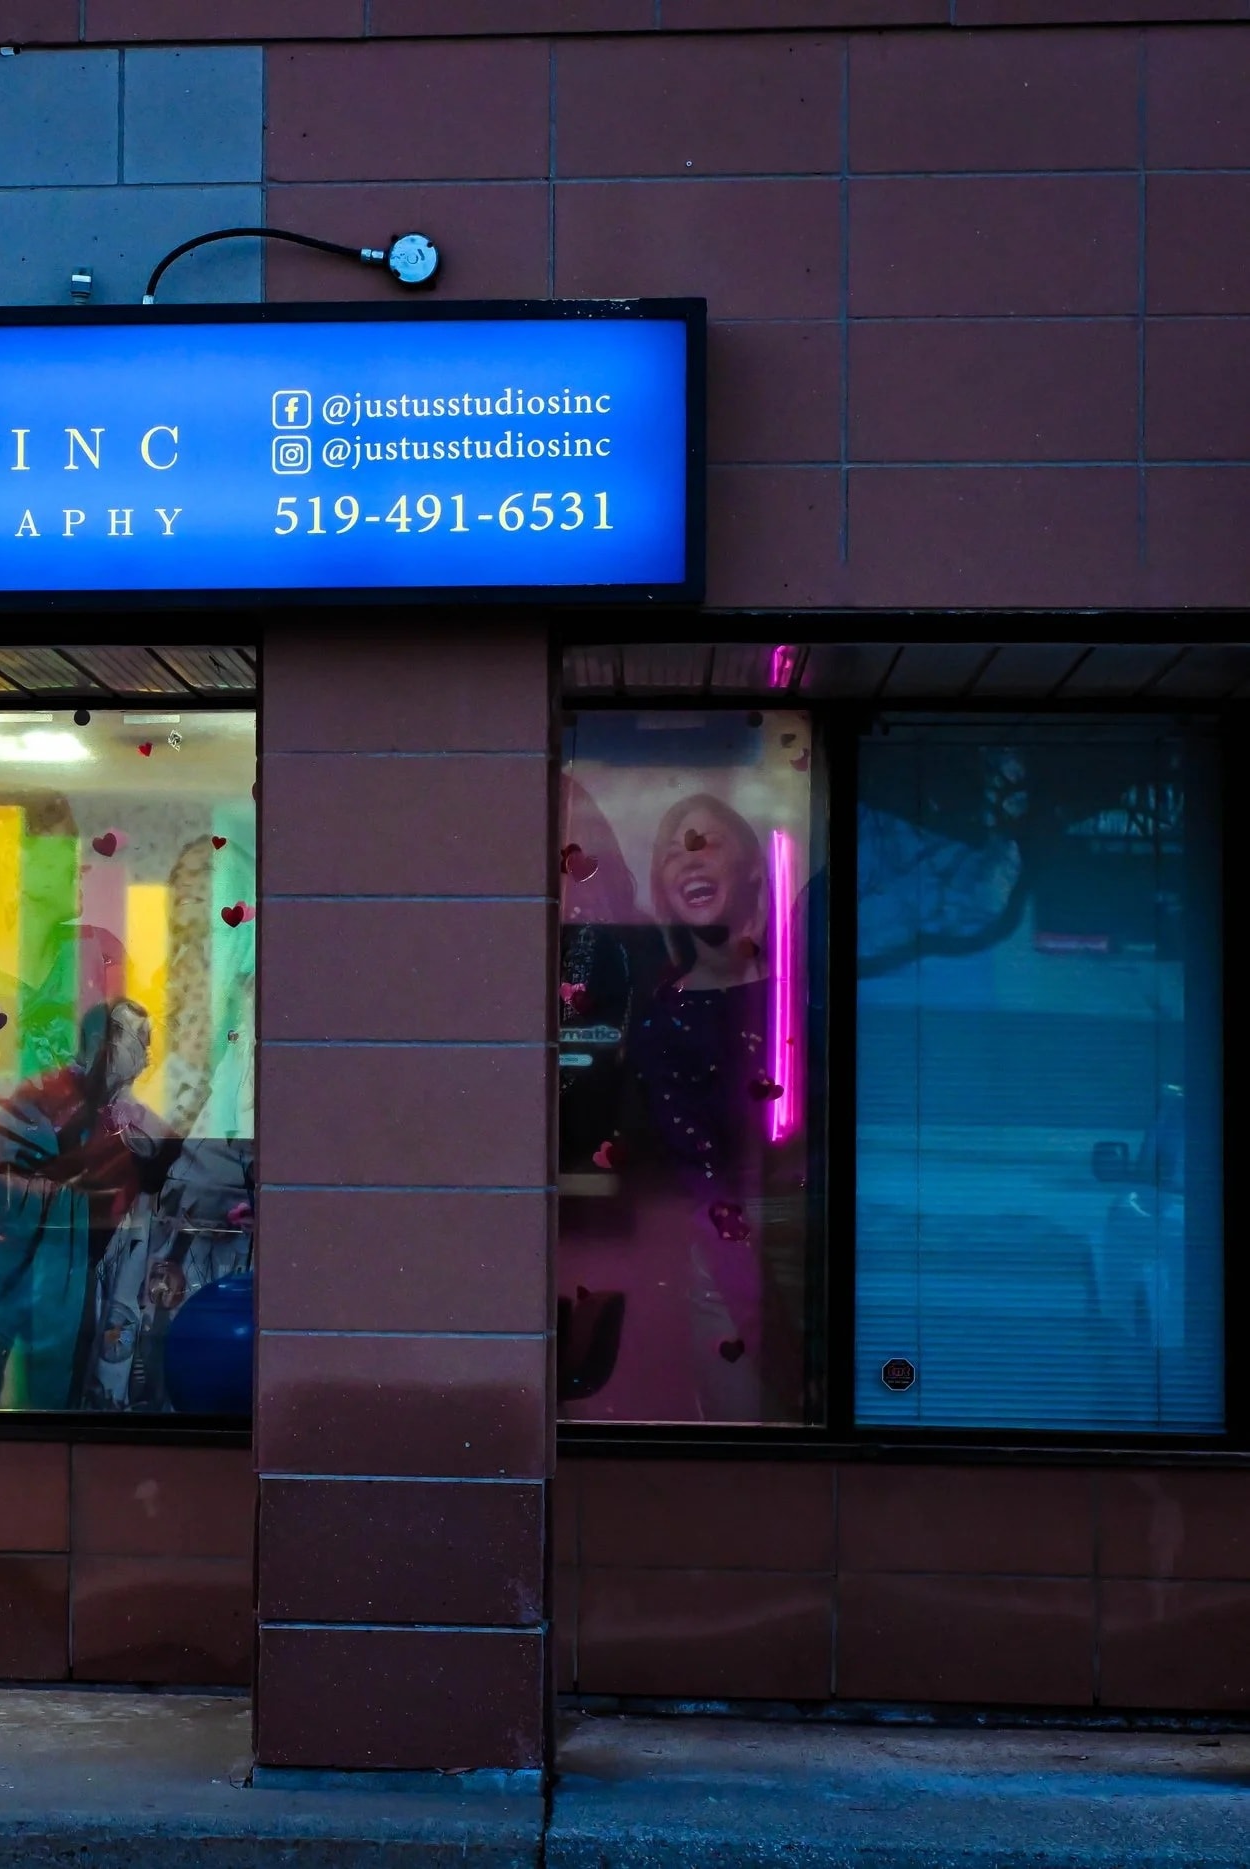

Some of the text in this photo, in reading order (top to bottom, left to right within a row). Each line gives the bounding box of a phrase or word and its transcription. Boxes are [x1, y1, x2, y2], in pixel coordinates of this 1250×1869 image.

[322, 388, 611, 426] @justusstudiosinc
[10, 425, 180, 471] INC
[322, 431, 611, 469] @justusstudiosinc
[273, 491, 614, 535] 519-491-6531
